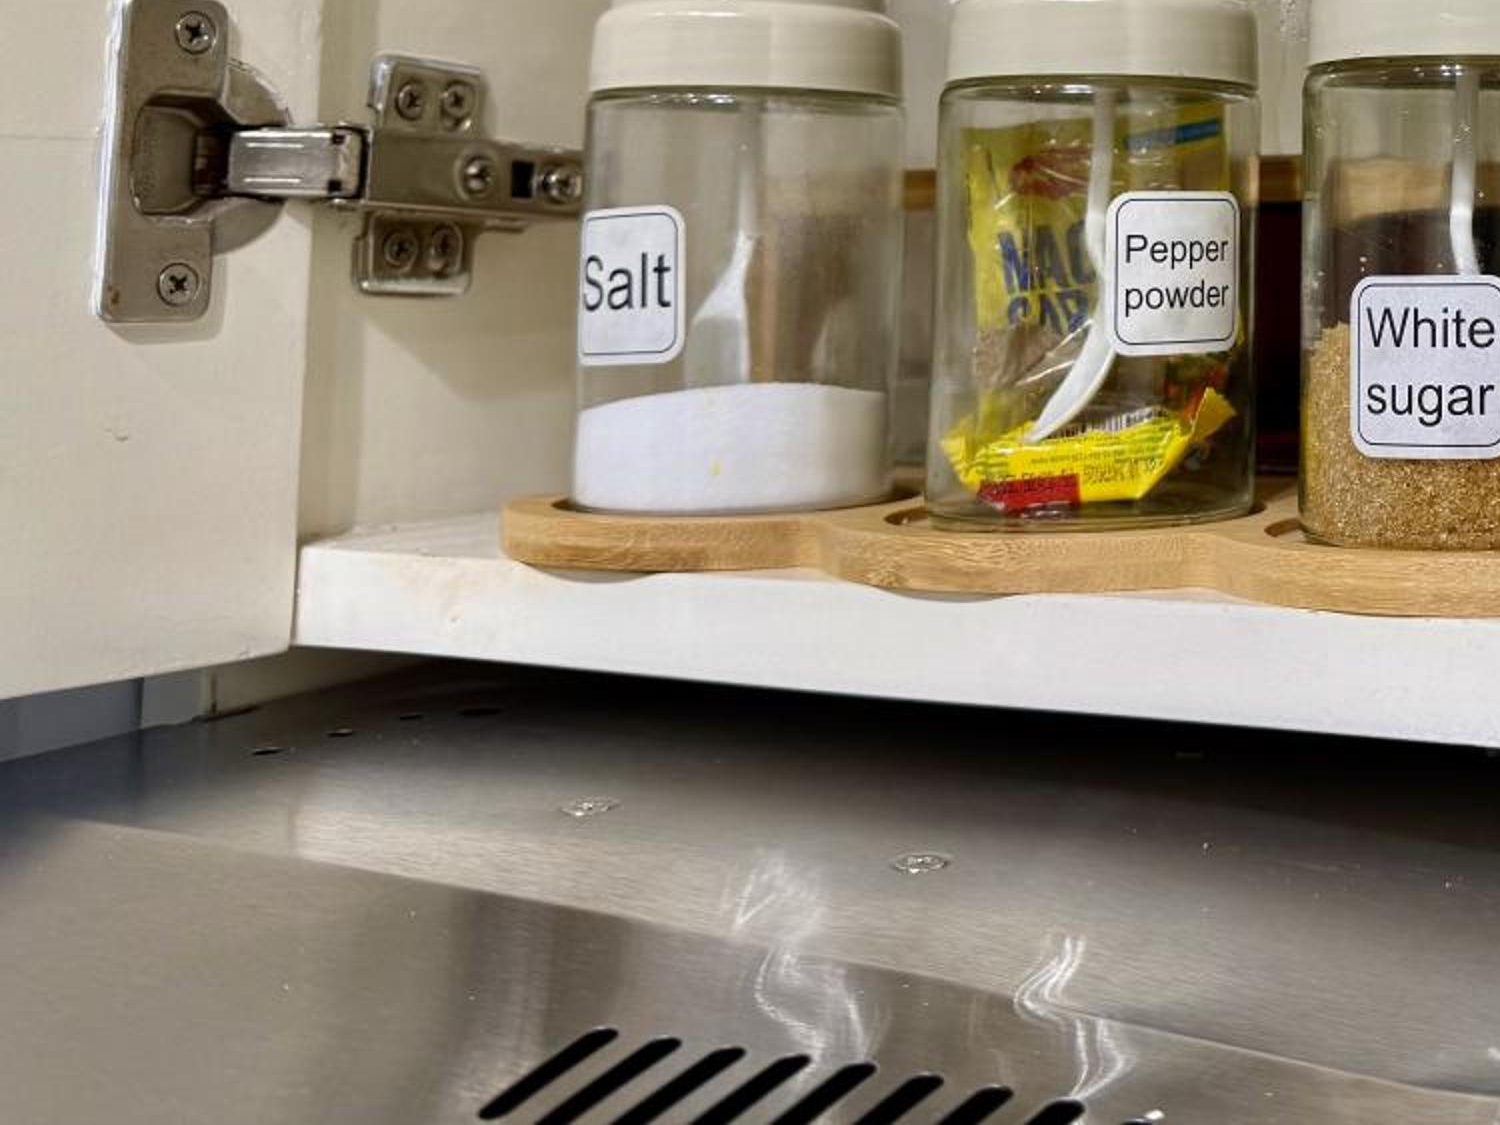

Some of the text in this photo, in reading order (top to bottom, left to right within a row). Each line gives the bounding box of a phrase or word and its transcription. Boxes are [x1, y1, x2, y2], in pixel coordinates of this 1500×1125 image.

[1124, 233, 1230, 269] Pepper
[583, 251, 672, 312] Salt
[1124, 279, 1230, 318] powder
[1366, 305, 1496, 348] White
[1366, 383, 1496, 428] sugar
